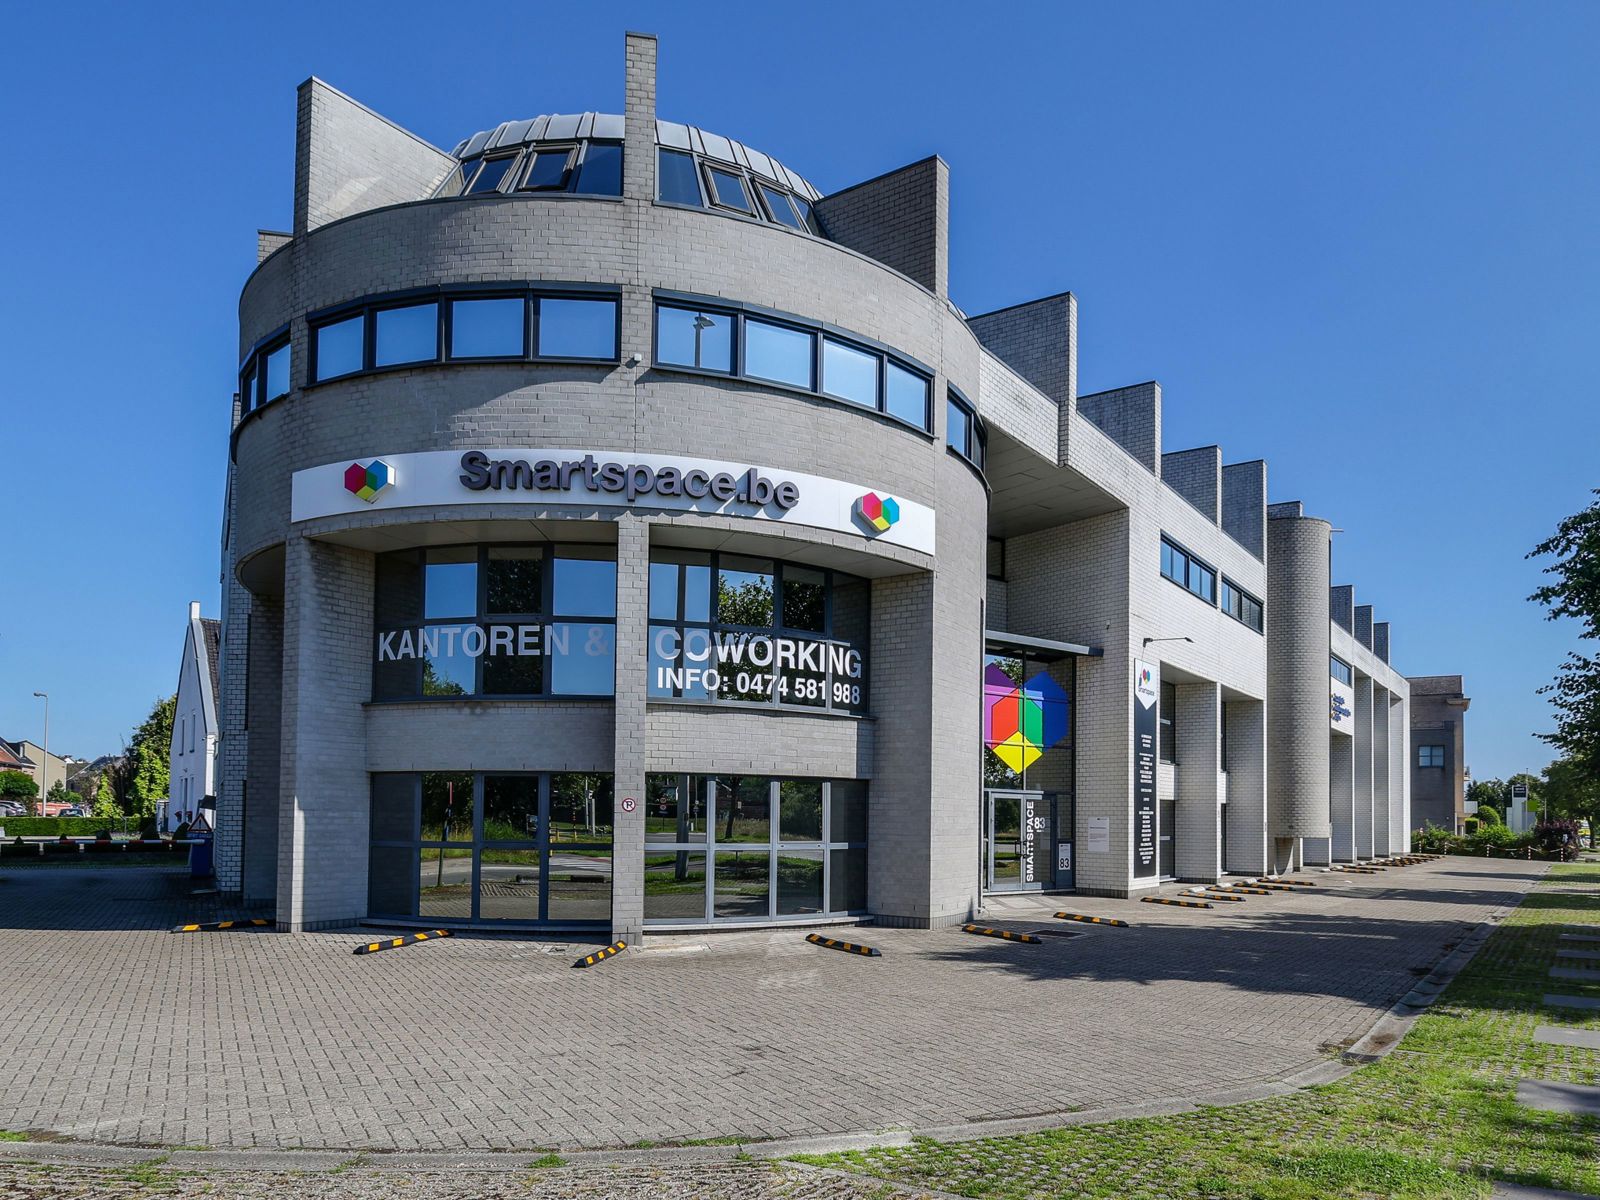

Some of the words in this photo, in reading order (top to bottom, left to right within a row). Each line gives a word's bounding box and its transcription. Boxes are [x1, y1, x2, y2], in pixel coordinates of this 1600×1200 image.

[459, 450, 800, 510] Smartspace.be
[378, 625, 569, 662] KANTOREN
[585, 627, 609, 656] &
[654, 628, 863, 679] COWORKING
[656, 666, 729, 692] INFO:
[736, 671, 788, 697] 0474
[794, 678, 826, 700] 581
[833, 682, 860, 705] 988
[1026, 801, 1034, 882] SMARTSPACE
[1034, 817, 1046, 829] 83
[1059, 857, 1070, 869] 83
